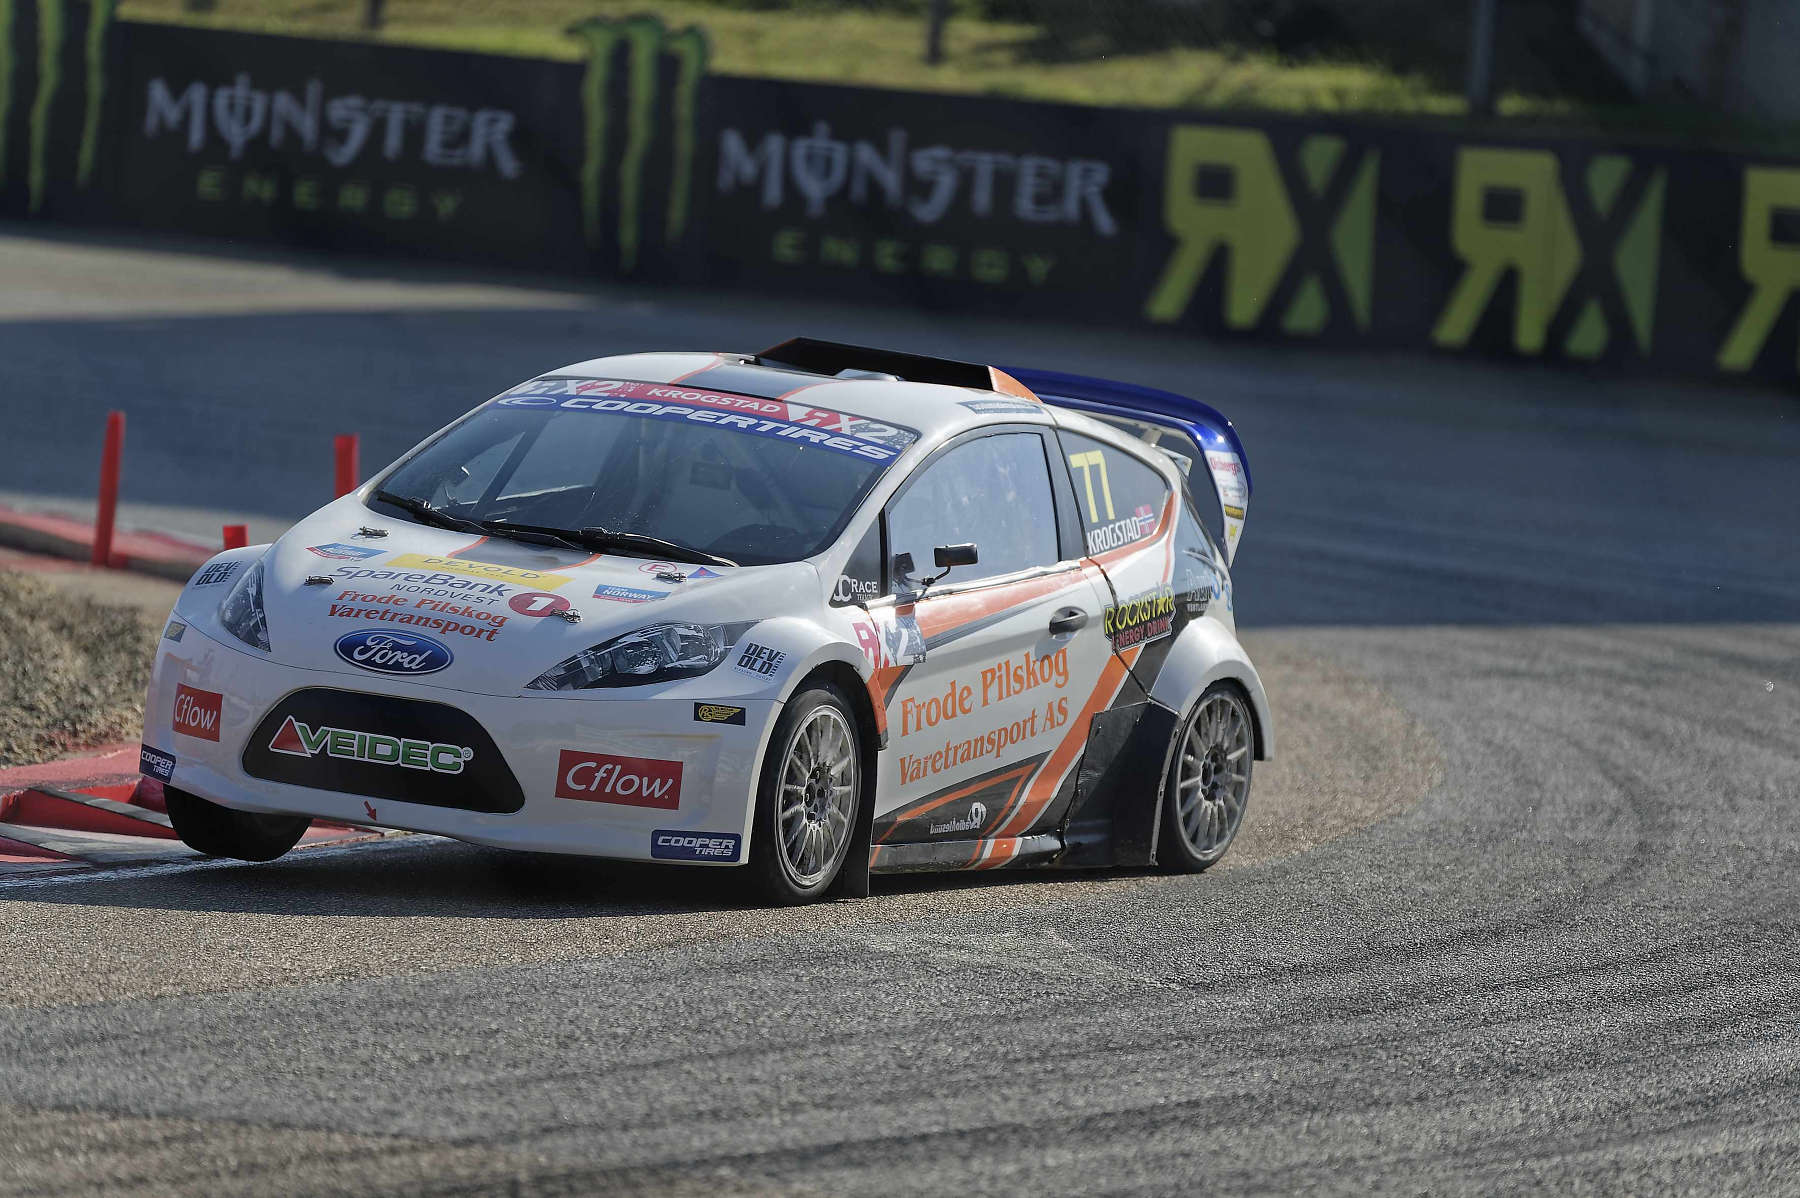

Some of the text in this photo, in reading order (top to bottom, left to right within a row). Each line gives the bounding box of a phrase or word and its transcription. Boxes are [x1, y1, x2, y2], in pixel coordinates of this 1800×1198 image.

[143, 73, 521, 179] MONSTER
[197, 168, 465, 221] ENERGY
[716, 119, 1117, 236] MONSTER
[772, 229, 1056, 285] ENERGY
[646, 387, 782, 414] KROGSTAD
[1069, 450, 1115, 523] 77
[1088, 517, 1141, 553] KROGSTAD
[424, 557, 540, 579] DEVOLD
[851, 579, 878, 593] RACE
[328, 566, 556, 611] SpareBank 1
[390, 584, 501, 606] NORDVEST
[328, 604, 501, 642] Varetransport
[336, 590, 511, 628] Frode Pilskog
[353, 634, 428, 671] Ford
[901, 648, 1069, 737] Frode Pilskog
[297, 722, 465, 774] VEIDEC
[899, 696, 1069, 786] Varetransport AS
[141, 751, 173, 770] COOPER
[153, 765, 170, 777] TIRES
[566, 761, 673, 798] Cflow
[657, 836, 735, 849] COOPER
[694, 847, 733, 856] TIRES
